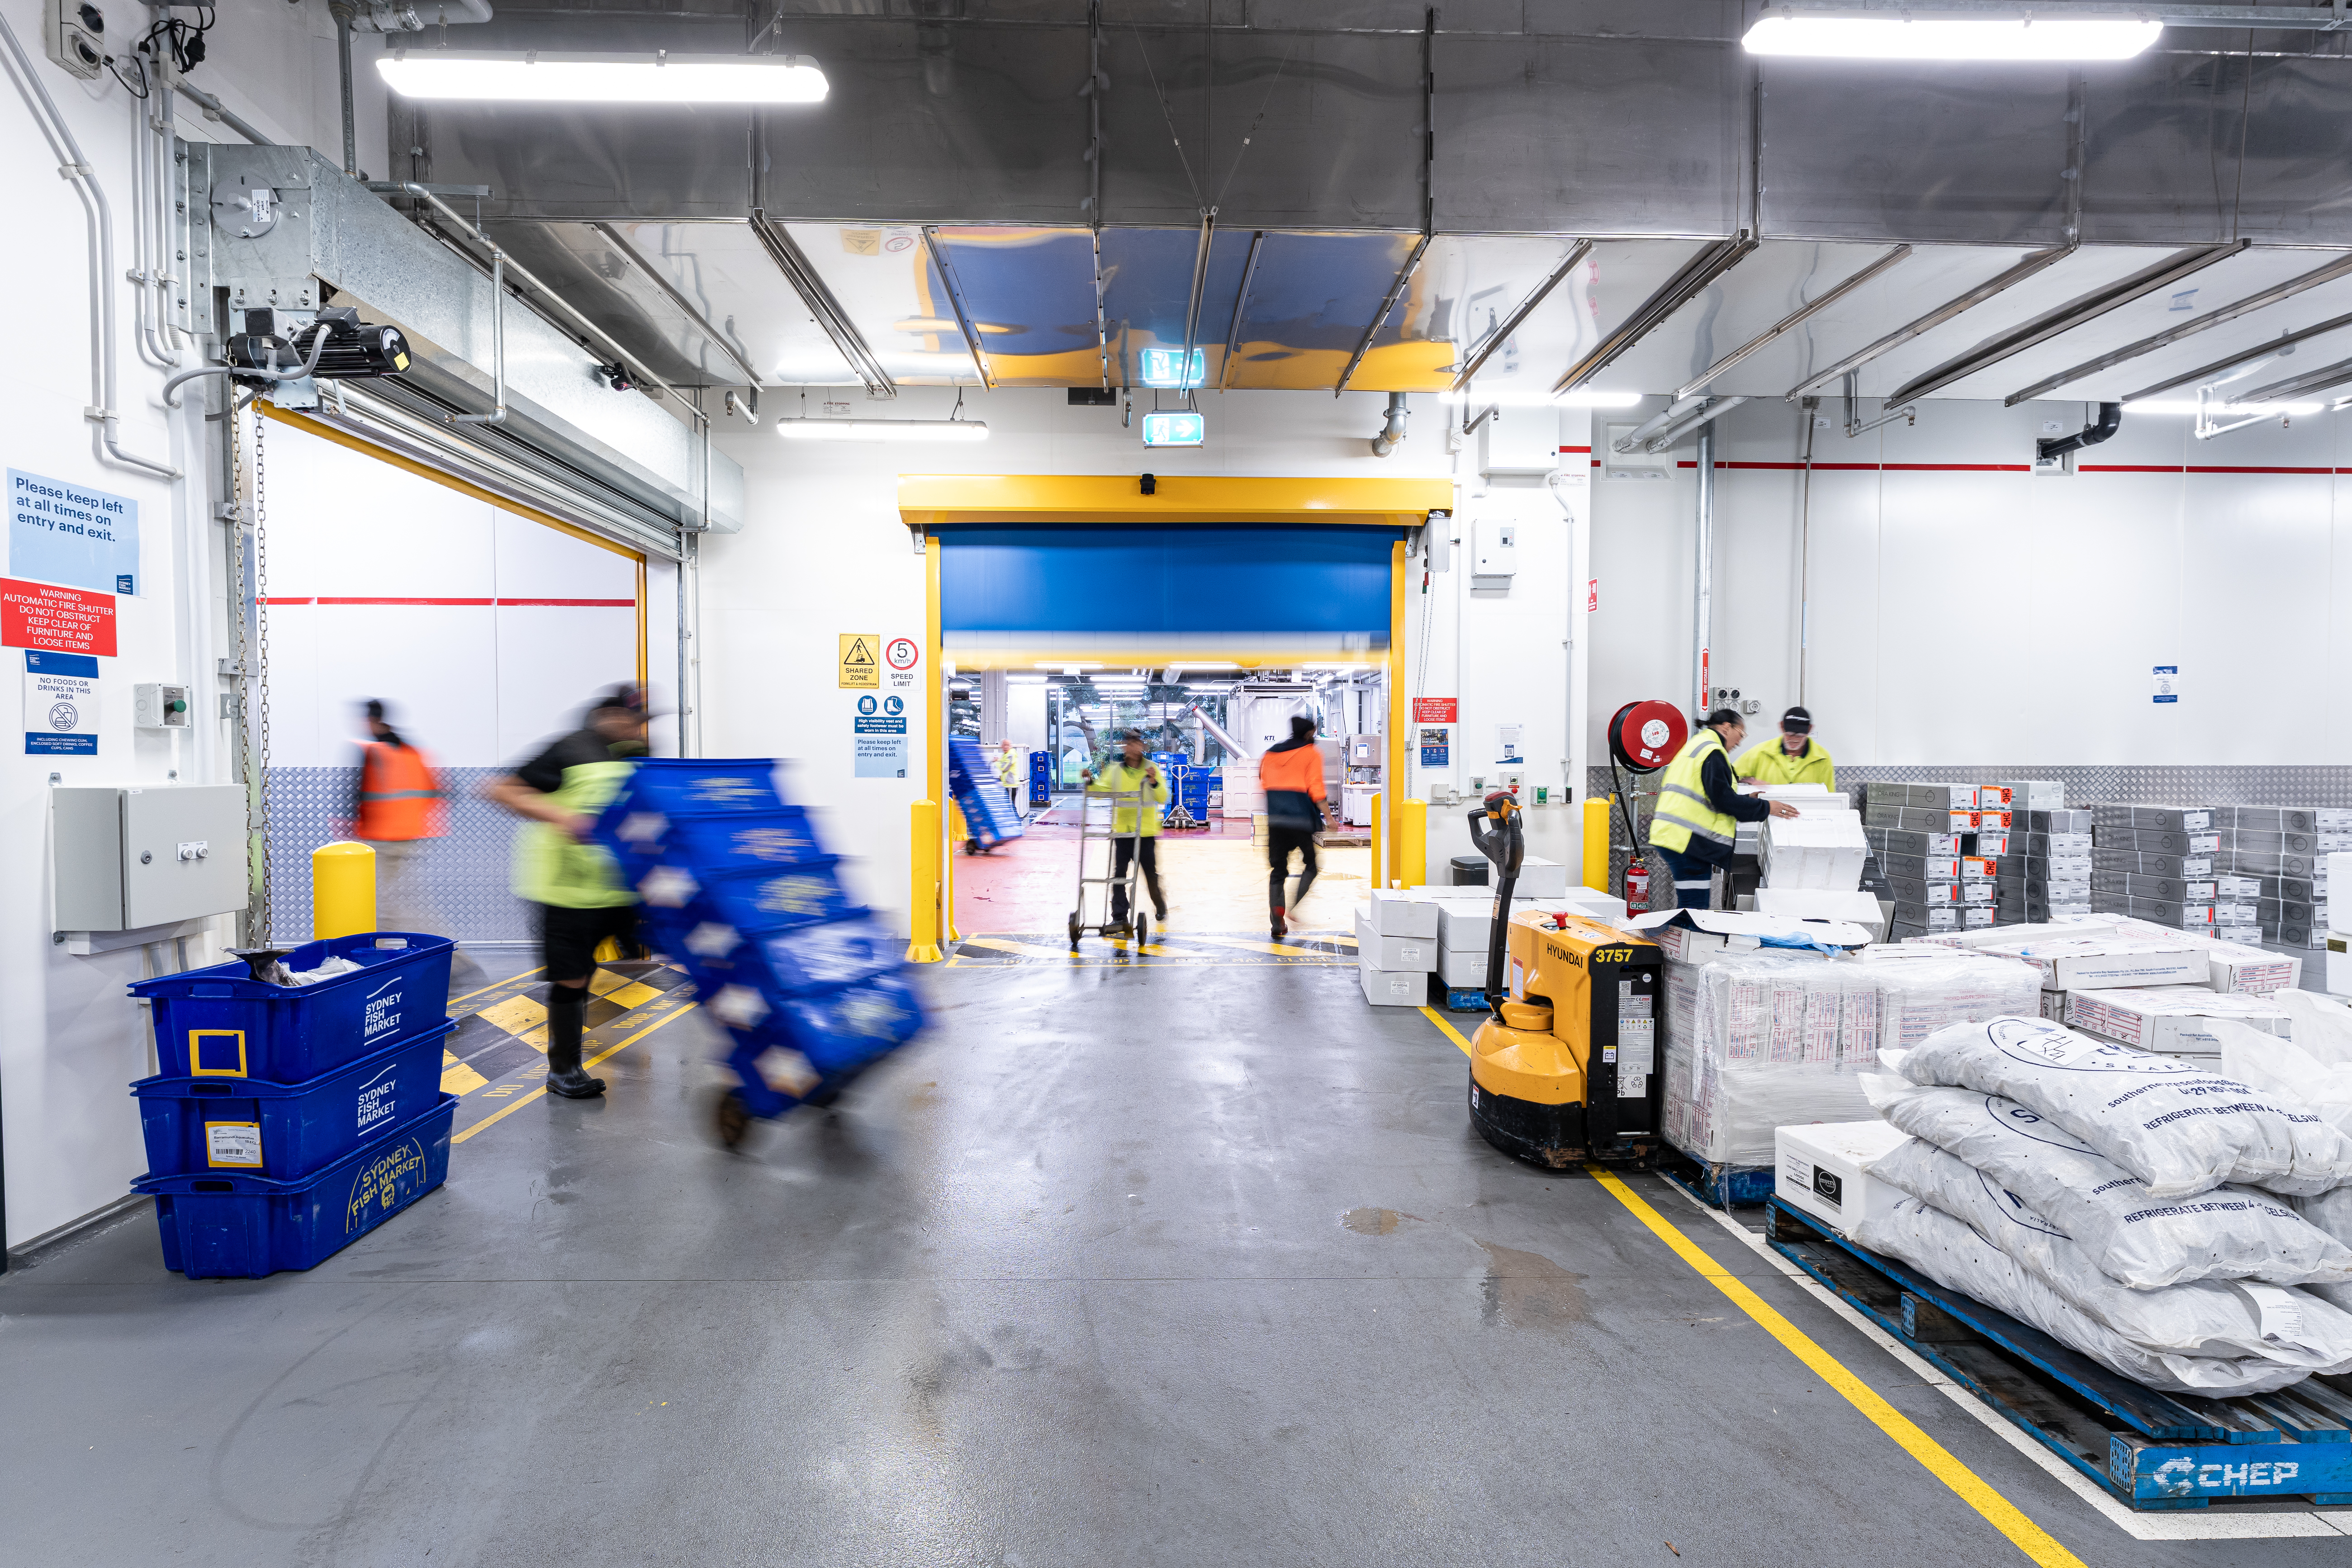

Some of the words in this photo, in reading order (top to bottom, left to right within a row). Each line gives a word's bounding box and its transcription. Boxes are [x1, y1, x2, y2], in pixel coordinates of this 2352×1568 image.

[16, 477, 63, 499] Please
[66, 489, 99, 509] keep
[102, 498, 123, 514] left
[16, 496, 30, 507] at
[34, 499, 50, 512] all
[54, 503, 92, 521] times
[95, 515, 111, 526] on
[17, 512, 55, 531] entry
[59, 521, 84, 535] and
[88, 528, 115, 542] exit.
[4, 593, 57, 608] AUTOMATIC
[59, 601, 76, 611] FIRE
[78, 603, 114, 616] SHUTTER
[40, 588, 81, 602] WARNING
[19, 605, 34, 614] DO
[36, 607, 55, 616] NOT
[57, 611, 100, 623] OBSTRUCT
[28, 616, 49, 626] KEEP
[51, 619, 78, 630] CLEAR
[80, 623, 92, 631] OF
[27, 626, 74, 639] FURNITURE
[76, 632, 93, 640] AND
[33, 637, 64, 647] LOOSE
[66, 640, 90, 650] ITEMS
[896, 643, 908, 658] 5
[1986, 860, 1996, 875] CHC
[1547, 943, 1583, 969] HYUNDAI
[1596, 949, 1633, 962] 3757
[365, 992, 402, 1015] SYDNEY
[365, 1009, 385, 1026] FISH
[365, 1013, 401, 1037] MARKET
[481, 1084, 525, 1097] DO
[611, 1013, 658, 1029] DOOR
[358, 1079, 396, 1105] SYDNEY
[357, 1100, 395, 1128] MARKET
[358, 1098, 379, 1117] FISH
[2143, 1107, 2212, 1131] REFRIGERATE
[2215, 1103, 2262, 1115] BETWEEN
[363, 1144, 409, 1188] SYDNEY
[351, 1183, 378, 1216] FISH
[379, 1156, 421, 1189] MARKET
[1820, 1178, 1835, 1186] myers
[2124, 1203, 2201, 1224] REFRIGERATE
[2200, 1201, 2247, 1212] BETWEEN
[2248, 1199, 2255, 1208] 4
[2264, 1206, 2300, 1221] CELSIUS
[2198, 1462, 2299, 1487] CHEP
